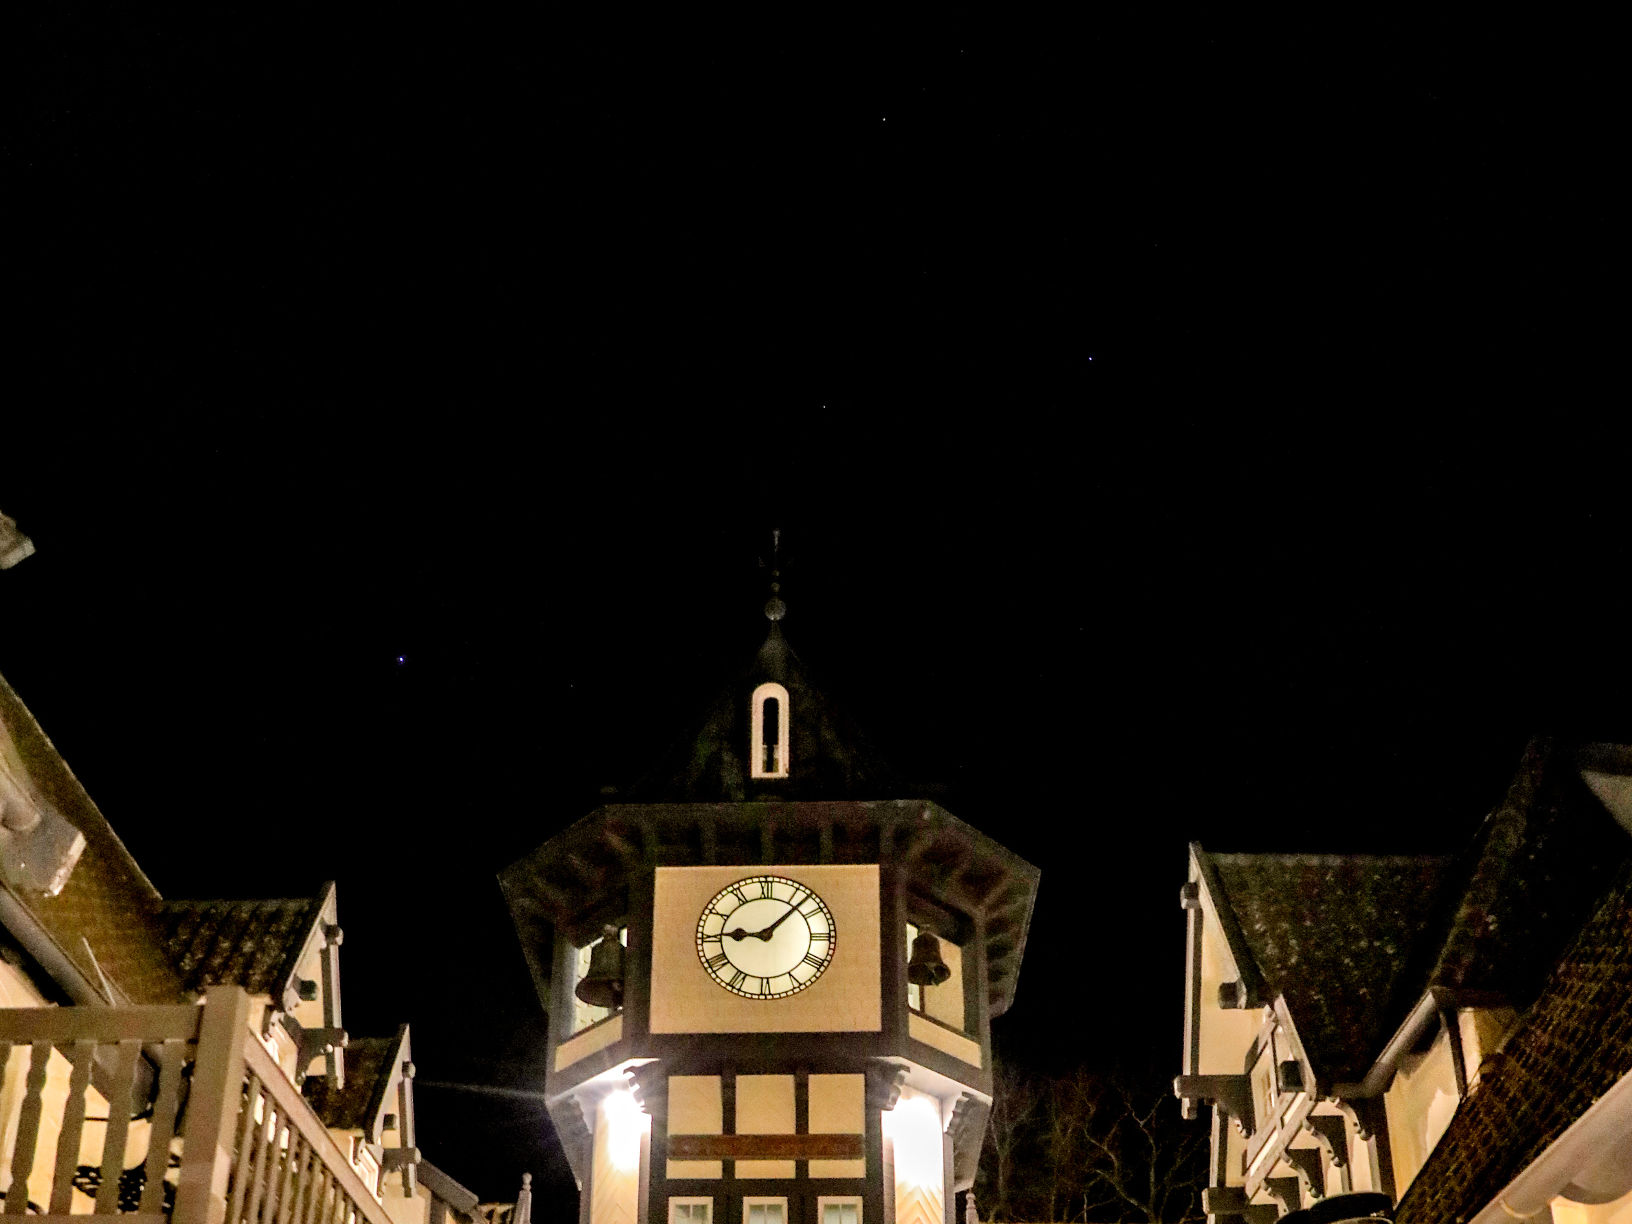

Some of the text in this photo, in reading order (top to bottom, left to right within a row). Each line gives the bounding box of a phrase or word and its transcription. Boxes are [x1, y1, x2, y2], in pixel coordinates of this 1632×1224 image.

[760, 881, 773, 899] XII
[803, 906, 823, 918] II
[811, 932, 831, 941] III
[760, 977, 771, 995] VI
[788, 971, 802, 987] V
